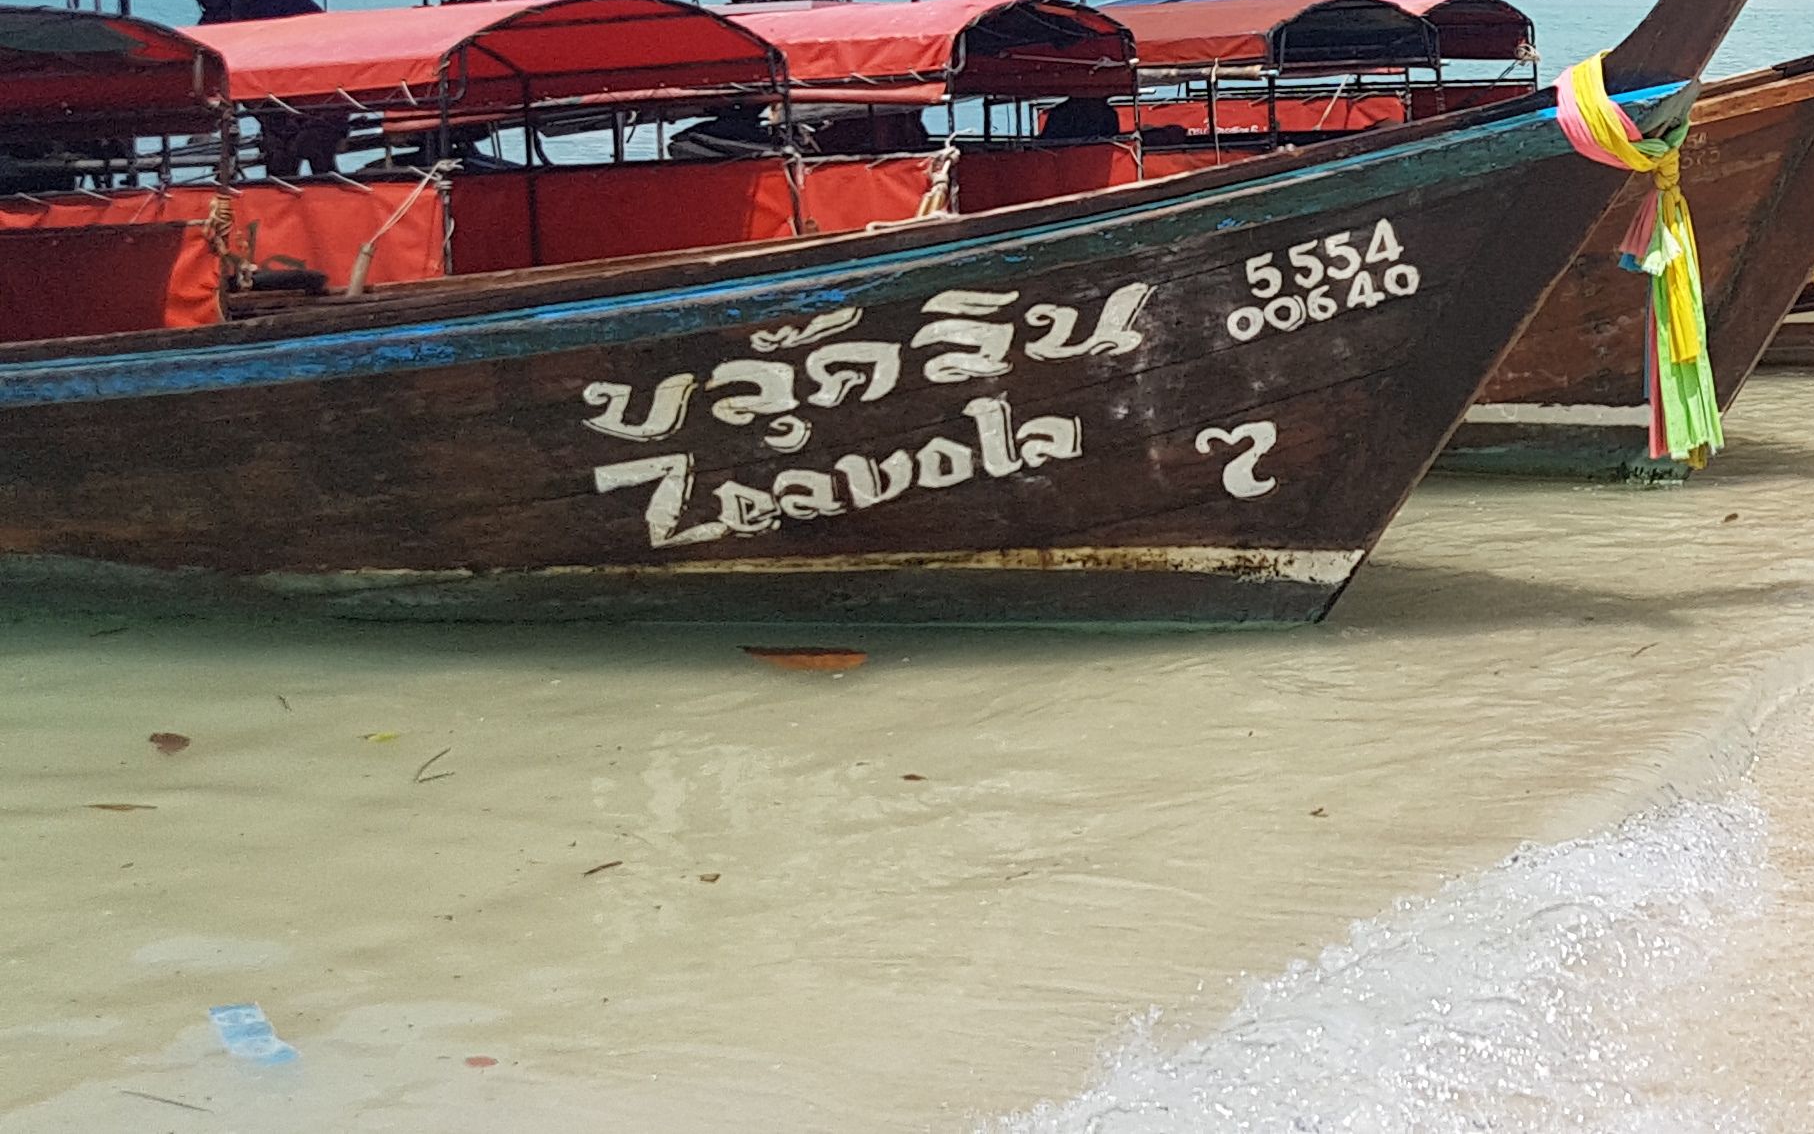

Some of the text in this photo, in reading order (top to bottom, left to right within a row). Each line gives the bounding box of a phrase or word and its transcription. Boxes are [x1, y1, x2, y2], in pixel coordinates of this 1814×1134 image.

[1245, 218, 1404, 299] 5554
[1226, 264, 1421, 342] 00640
[594, 391, 1083, 548] Zeavola
